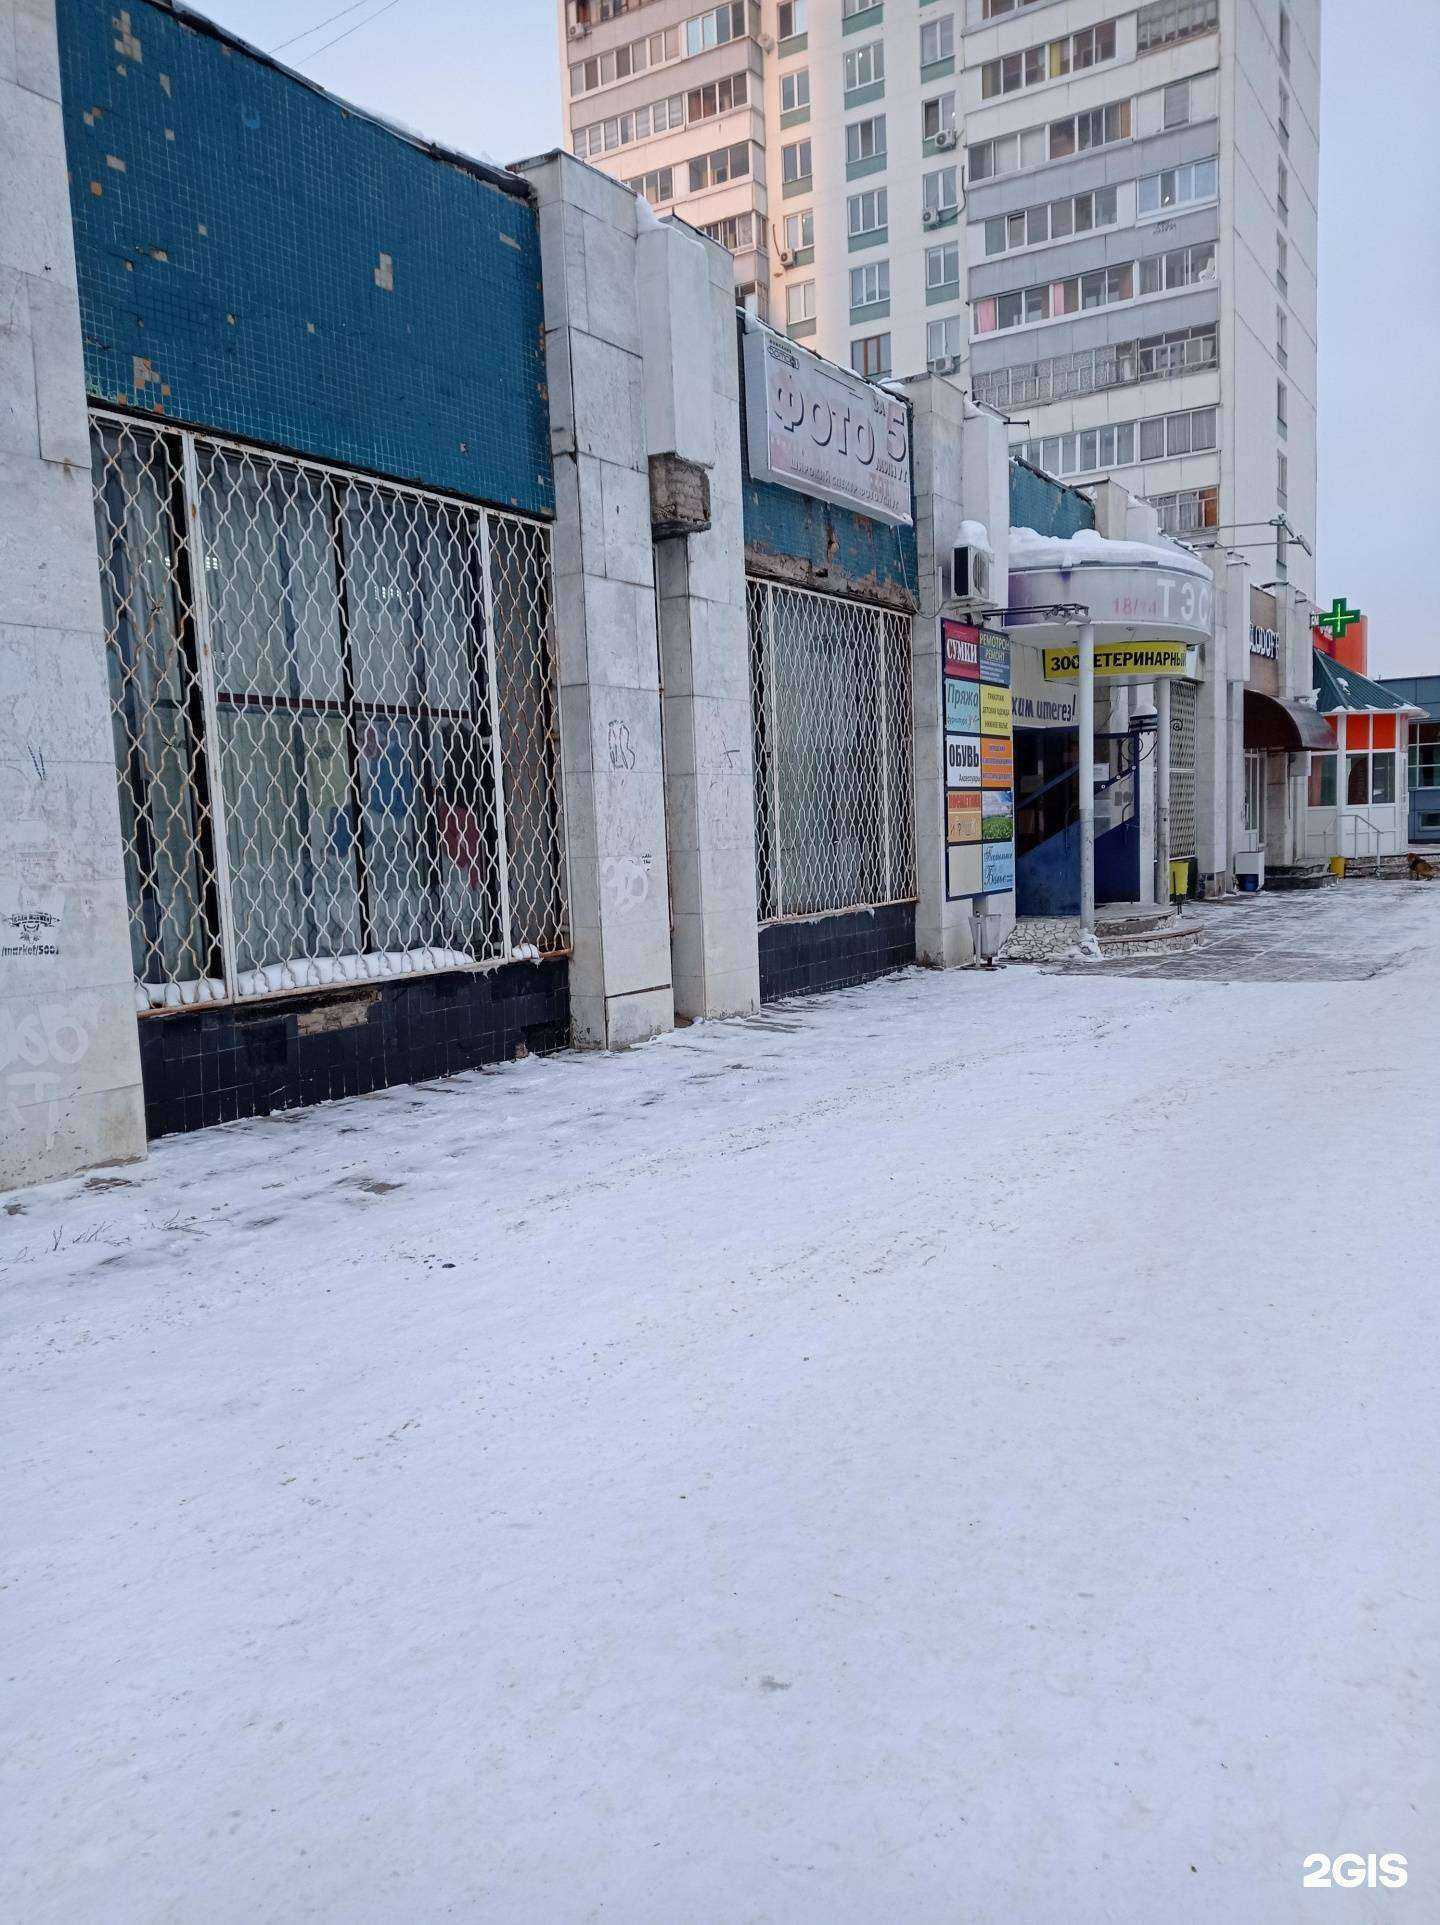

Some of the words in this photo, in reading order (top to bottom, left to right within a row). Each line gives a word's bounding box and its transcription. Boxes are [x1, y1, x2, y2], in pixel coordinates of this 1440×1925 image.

[774, 374, 875, 466] ФОТО
[886, 403, 907, 463] 5
[946, 638, 978, 664] СУМКИ
[947, 683, 979, 709] Пряжа
[949, 743, 979, 768] ОБУВЬ
